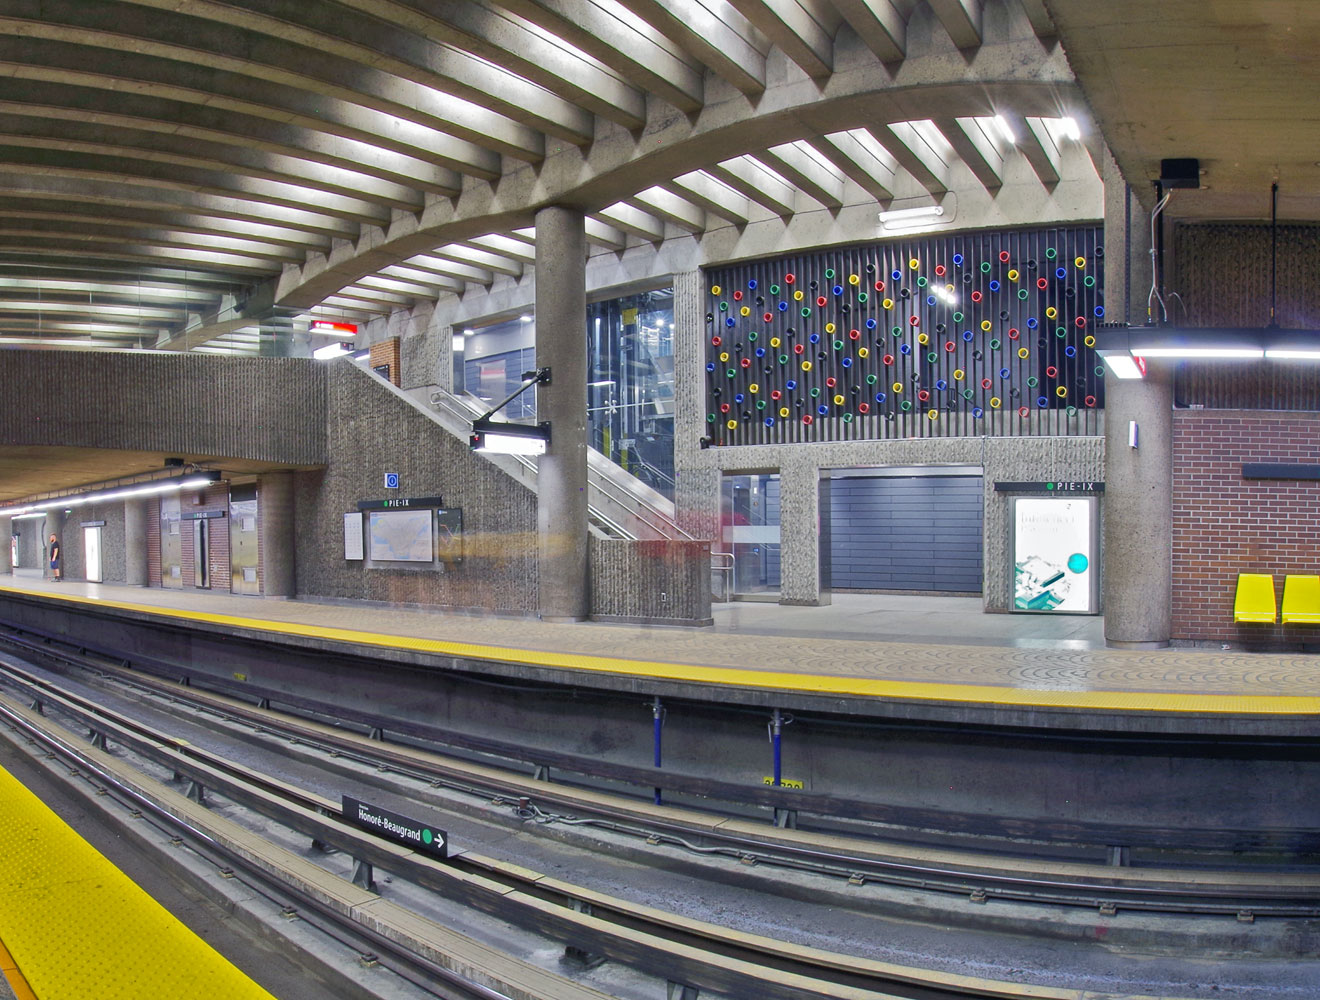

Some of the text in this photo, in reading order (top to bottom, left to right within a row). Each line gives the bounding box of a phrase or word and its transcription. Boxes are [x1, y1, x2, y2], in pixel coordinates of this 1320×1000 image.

[1057, 482, 1093, 490] PIE-IX
[388, 499, 409, 507] PIE-IX
[358, 808, 421, 841] Honoré-Beaugrand
